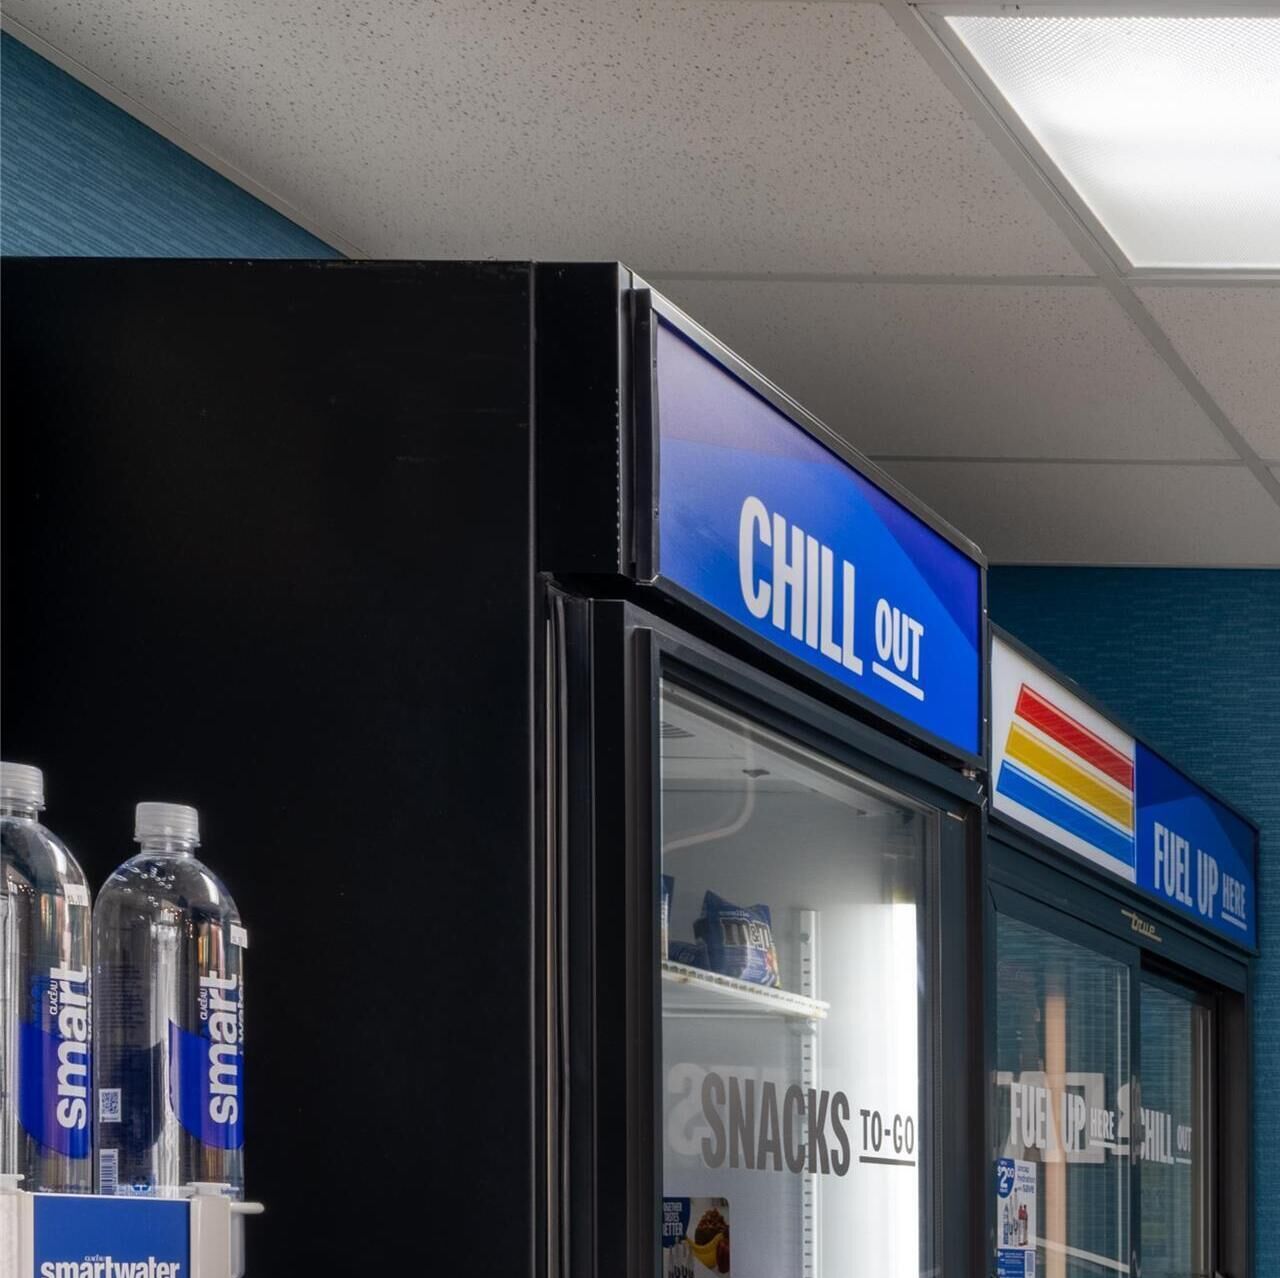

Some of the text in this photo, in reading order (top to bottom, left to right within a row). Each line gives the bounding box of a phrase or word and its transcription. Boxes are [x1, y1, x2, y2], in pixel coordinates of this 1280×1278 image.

[739, 496, 924, 681] CHILL OUT
[1154, 821, 1246, 919] FUEL UP HERE
[50, 965, 88, 1130] smart
[201, 969, 238, 1125] smart
[700, 1072, 914, 1177] SNACKS TO-GO
[1011, 1082, 1057, 1149] FUEL
[1061, 1092, 1086, 1152] UP
[1090, 1107, 1114, 1140] HERE
[1177, 1125, 1192, 1152] OUT
